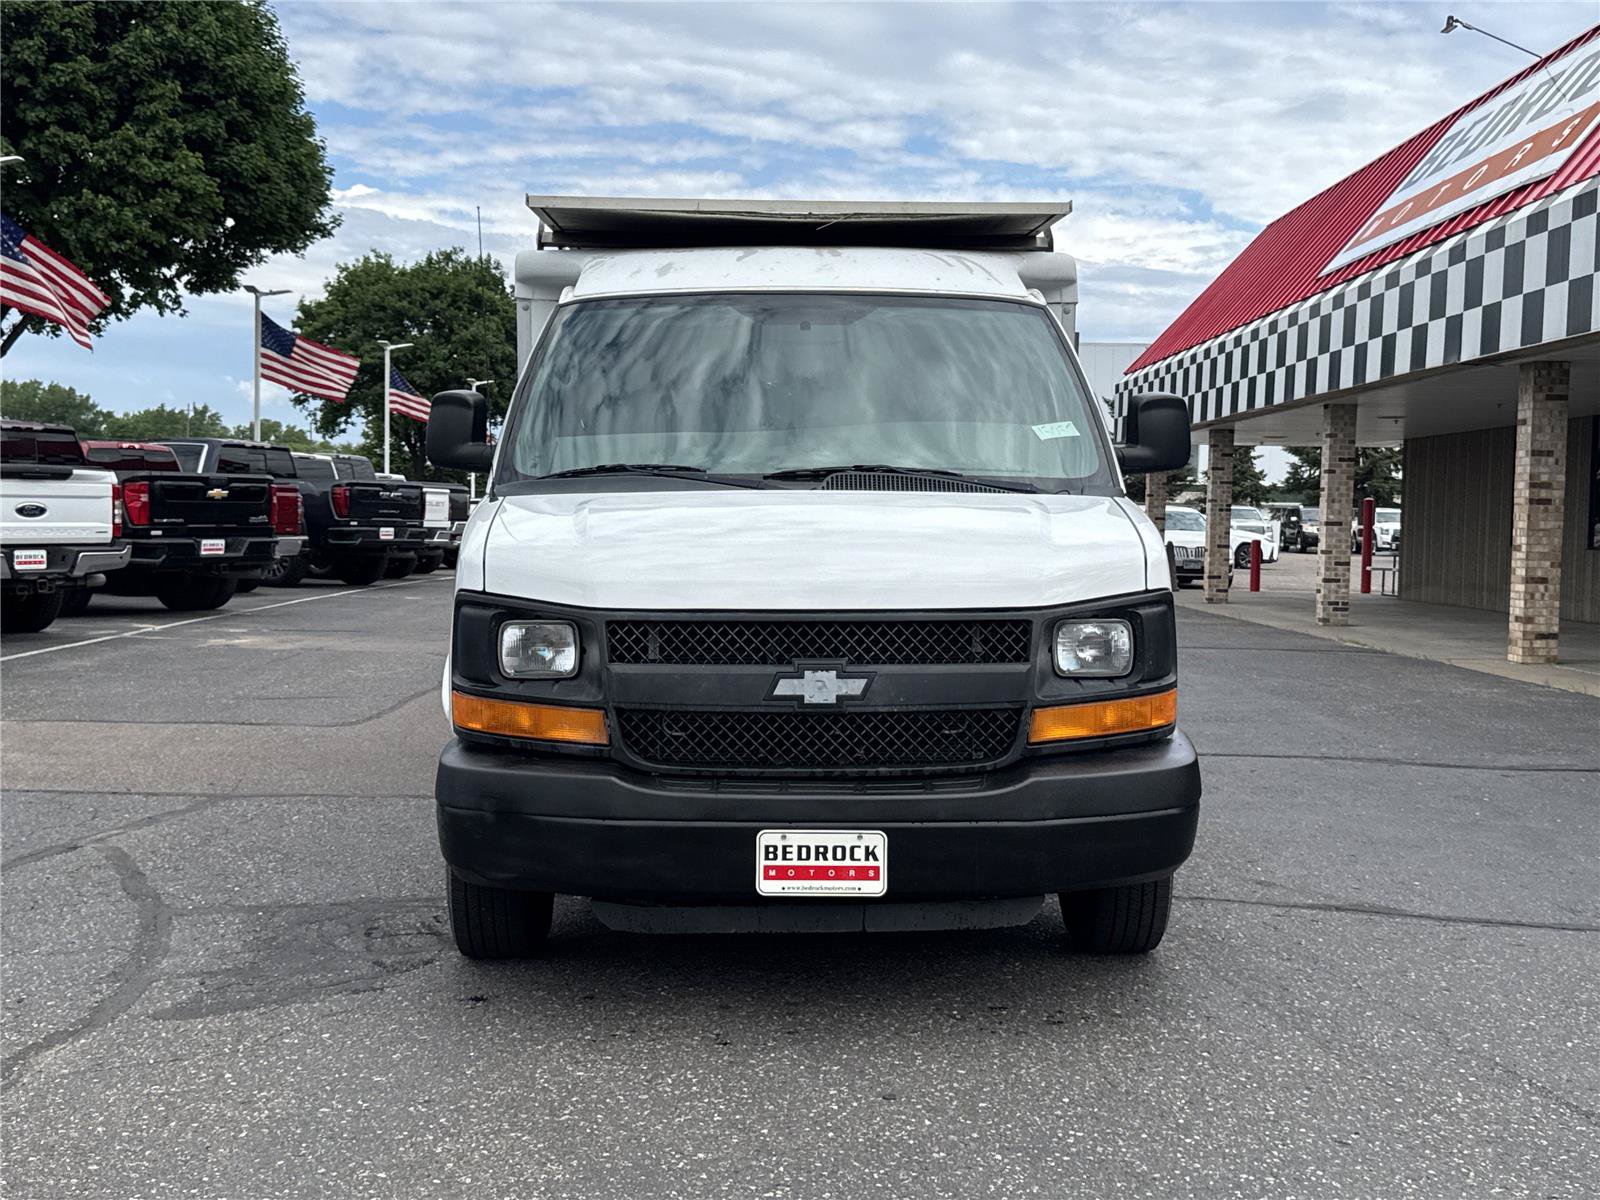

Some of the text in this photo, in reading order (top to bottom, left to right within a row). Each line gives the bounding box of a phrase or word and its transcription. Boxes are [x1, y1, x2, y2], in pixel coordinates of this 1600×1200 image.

[1359, 117, 1582, 240] MOTORS
[764, 844, 880, 862] BEDROCK
[768, 869, 875, 877] MOTORS
